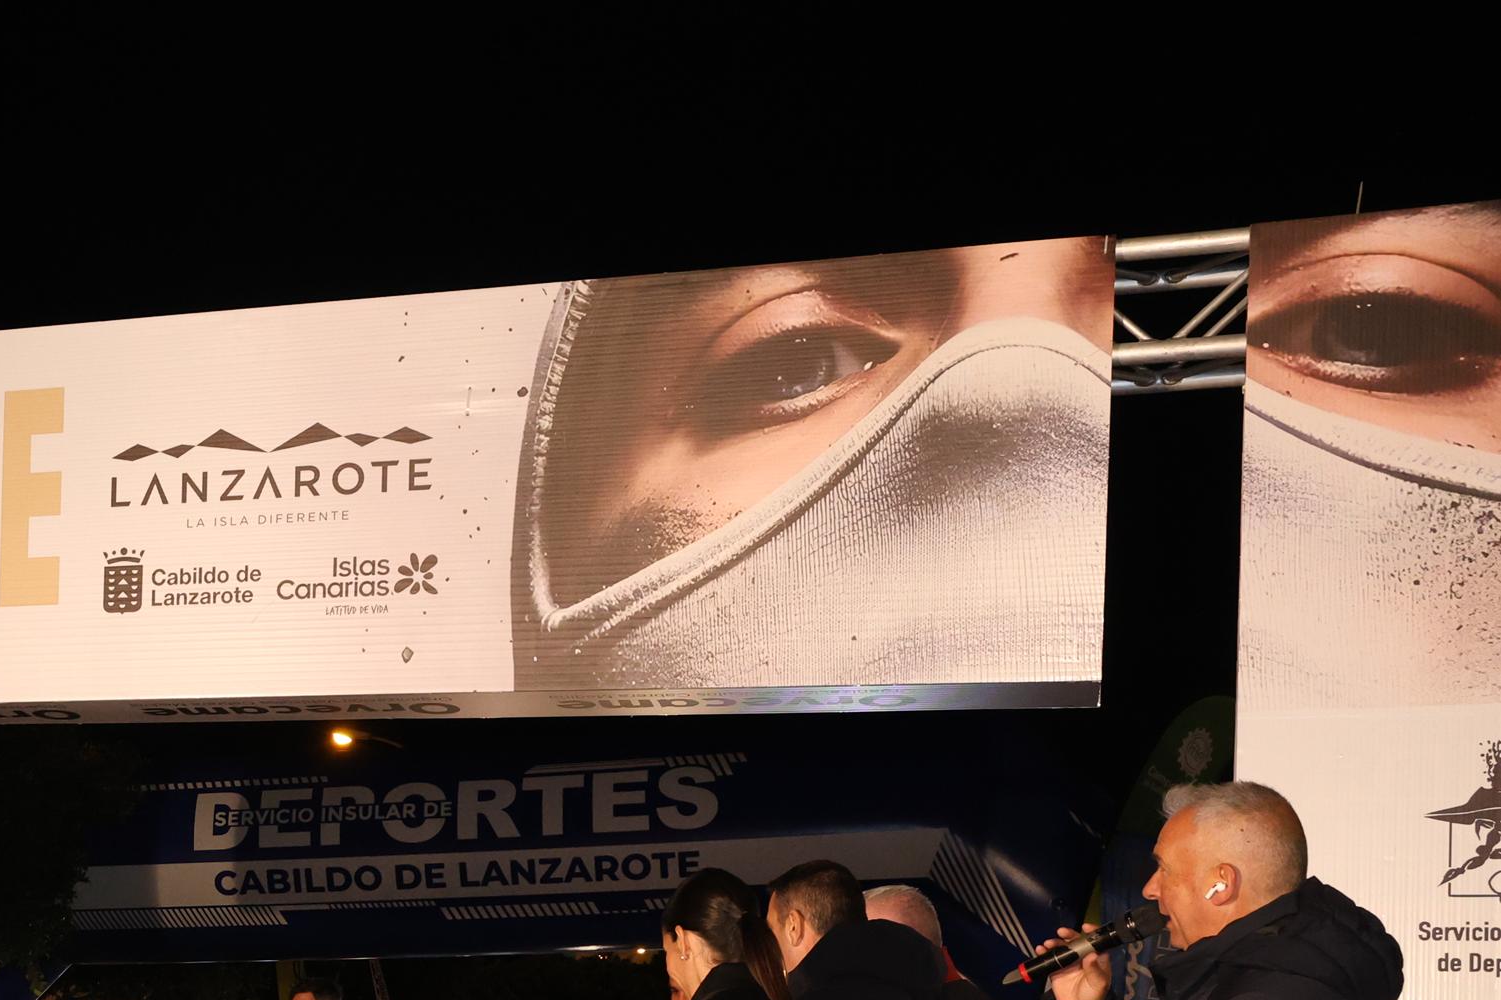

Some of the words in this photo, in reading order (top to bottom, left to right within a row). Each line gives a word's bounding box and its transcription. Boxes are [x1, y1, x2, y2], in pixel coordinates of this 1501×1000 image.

[110, 457, 433, 508] LANZAROTE
[186, 516, 205, 529] LA
[213, 514, 250, 527] ISLA
[258, 510, 350, 525] DIFERENTE
[152, 566, 229, 587] Cabildo
[236, 565, 262, 583] de
[332, 556, 390, 578] Islas
[151, 586, 253, 607] Lanzarote
[277, 577, 390, 600] Canarias
[325, 604, 357, 616] LATITUD
[359, 604, 369, 615] DE
[370, 603, 389, 615] VIDA
[140, 701, 460, 718] Orvecame
[556, 694, 916, 712] Orvecame
[193, 765, 720, 851] DEPORTES
[214, 808, 315, 827] SERVICIO
[320, 804, 417, 822] INSULAR
[423, 801, 453, 818] DE
[214, 865, 382, 895] CABILDO
[394, 863, 447, 889] DE
[460, 851, 701, 889] LANZAROTE
[1418, 921, 1501, 941] Servicio
[1437, 952, 1462, 972] de
